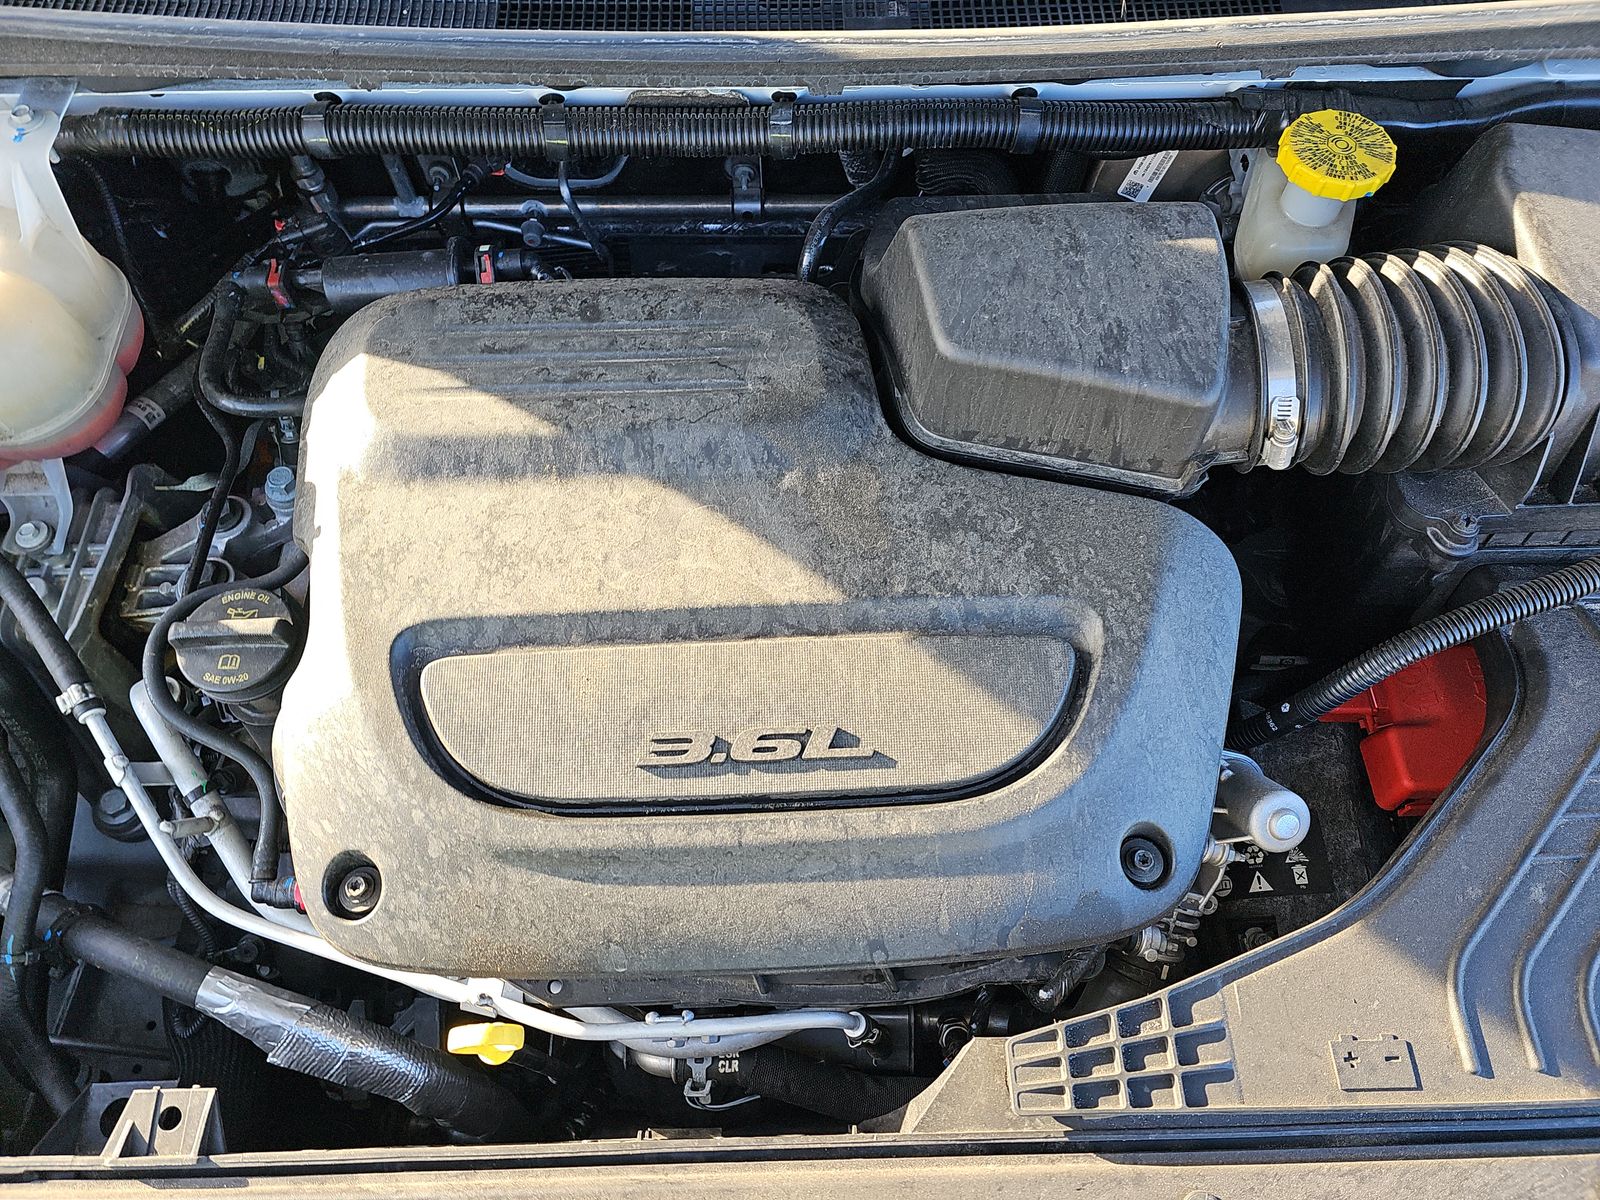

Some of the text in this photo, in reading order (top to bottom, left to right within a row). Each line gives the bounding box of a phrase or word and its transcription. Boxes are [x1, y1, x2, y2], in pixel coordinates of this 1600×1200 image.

[1334, 115, 1356, 124] FLUID
[1338, 111, 1374, 127] CONTAINER
[1373, 127, 1391, 144] SEALED
[1305, 145, 1338, 169] UNIQUEMENT
[1320, 147, 1358, 160] CONTENANT
[1326, 167, 1371, 176] REMPLISSAGE
[1341, 162, 1368, 171] UTILISER
[221, 591, 271, 605] ENGINE OIL
[203, 672, 249, 685] SAE 0W-20
[635, 725, 877, 768] 3.6L
[718, 1059, 739, 1074] CLR
